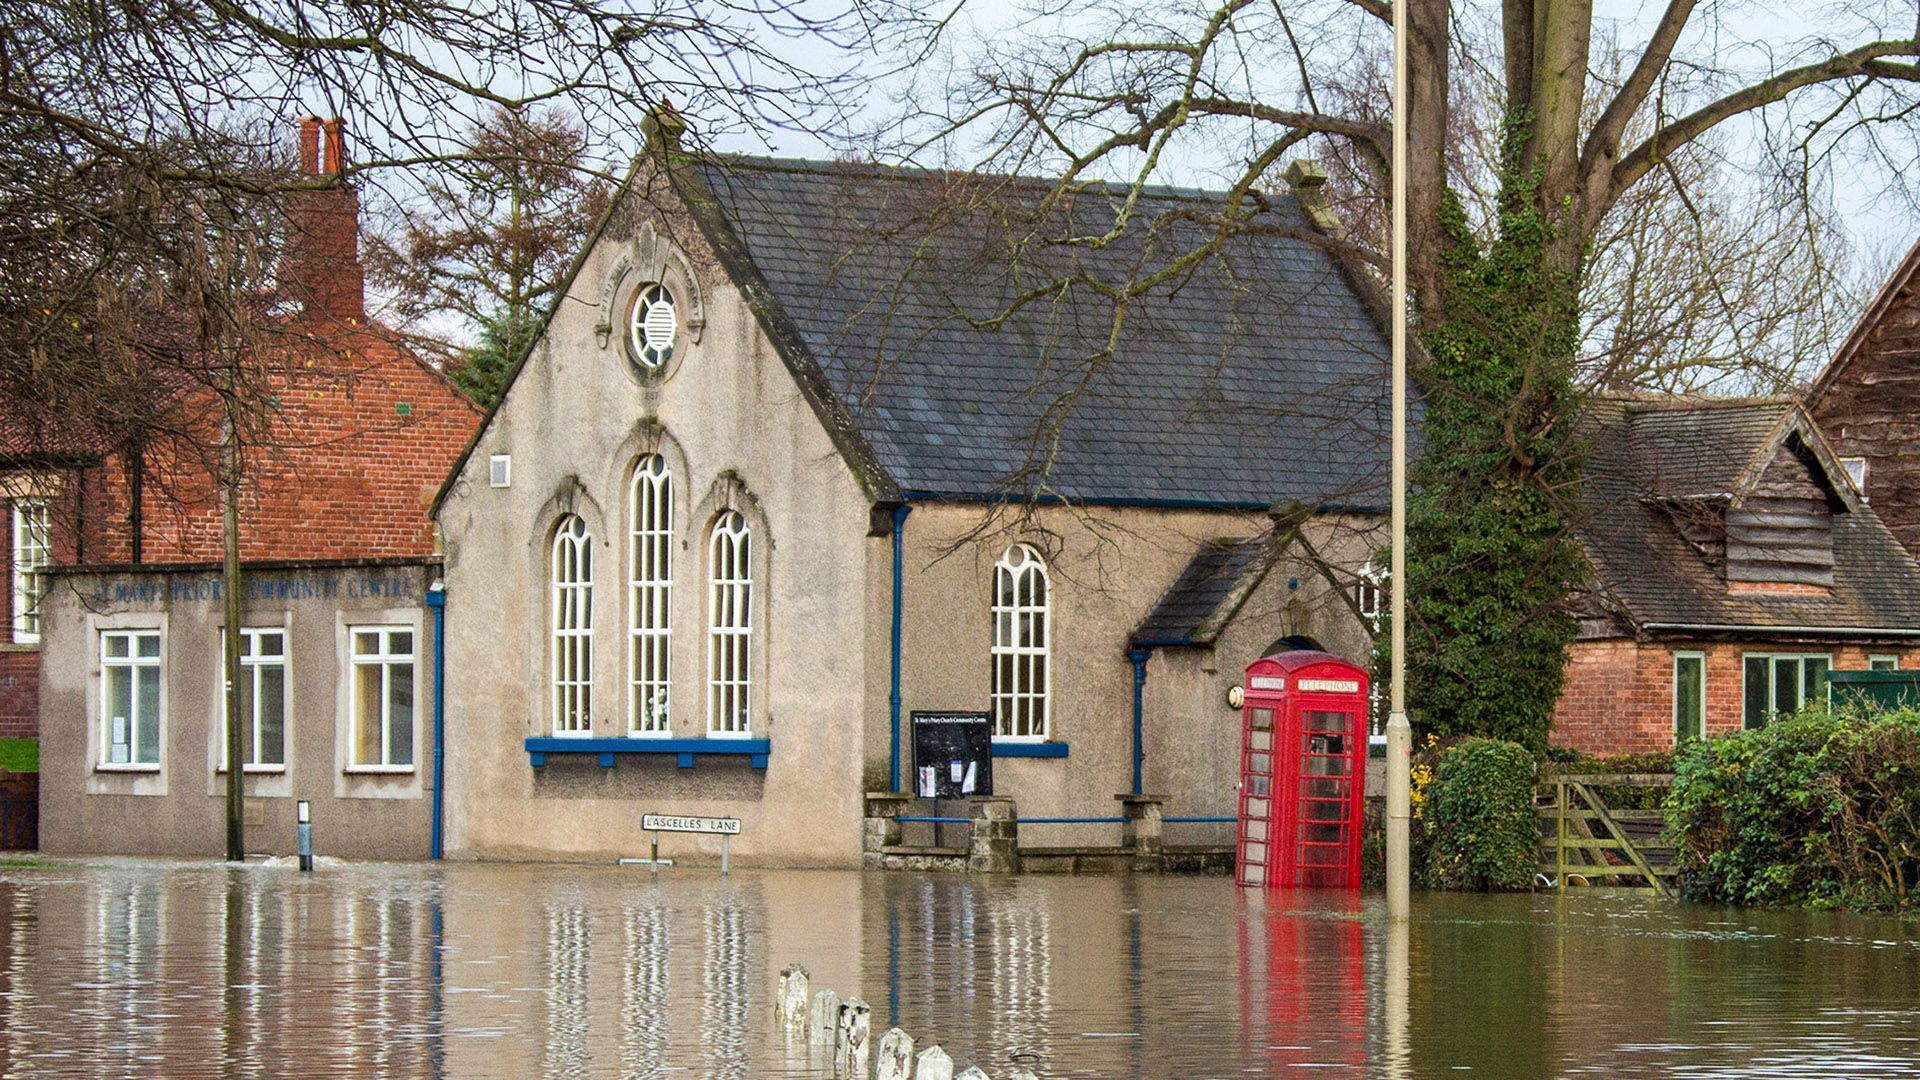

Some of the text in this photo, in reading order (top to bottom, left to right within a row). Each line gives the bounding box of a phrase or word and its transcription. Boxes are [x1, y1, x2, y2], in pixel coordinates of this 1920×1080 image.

[347, 575, 411, 599] CENTRE
[1301, 680, 1355, 691] TELEPHONE
[646, 817, 737, 831] LASCELLES LANE
